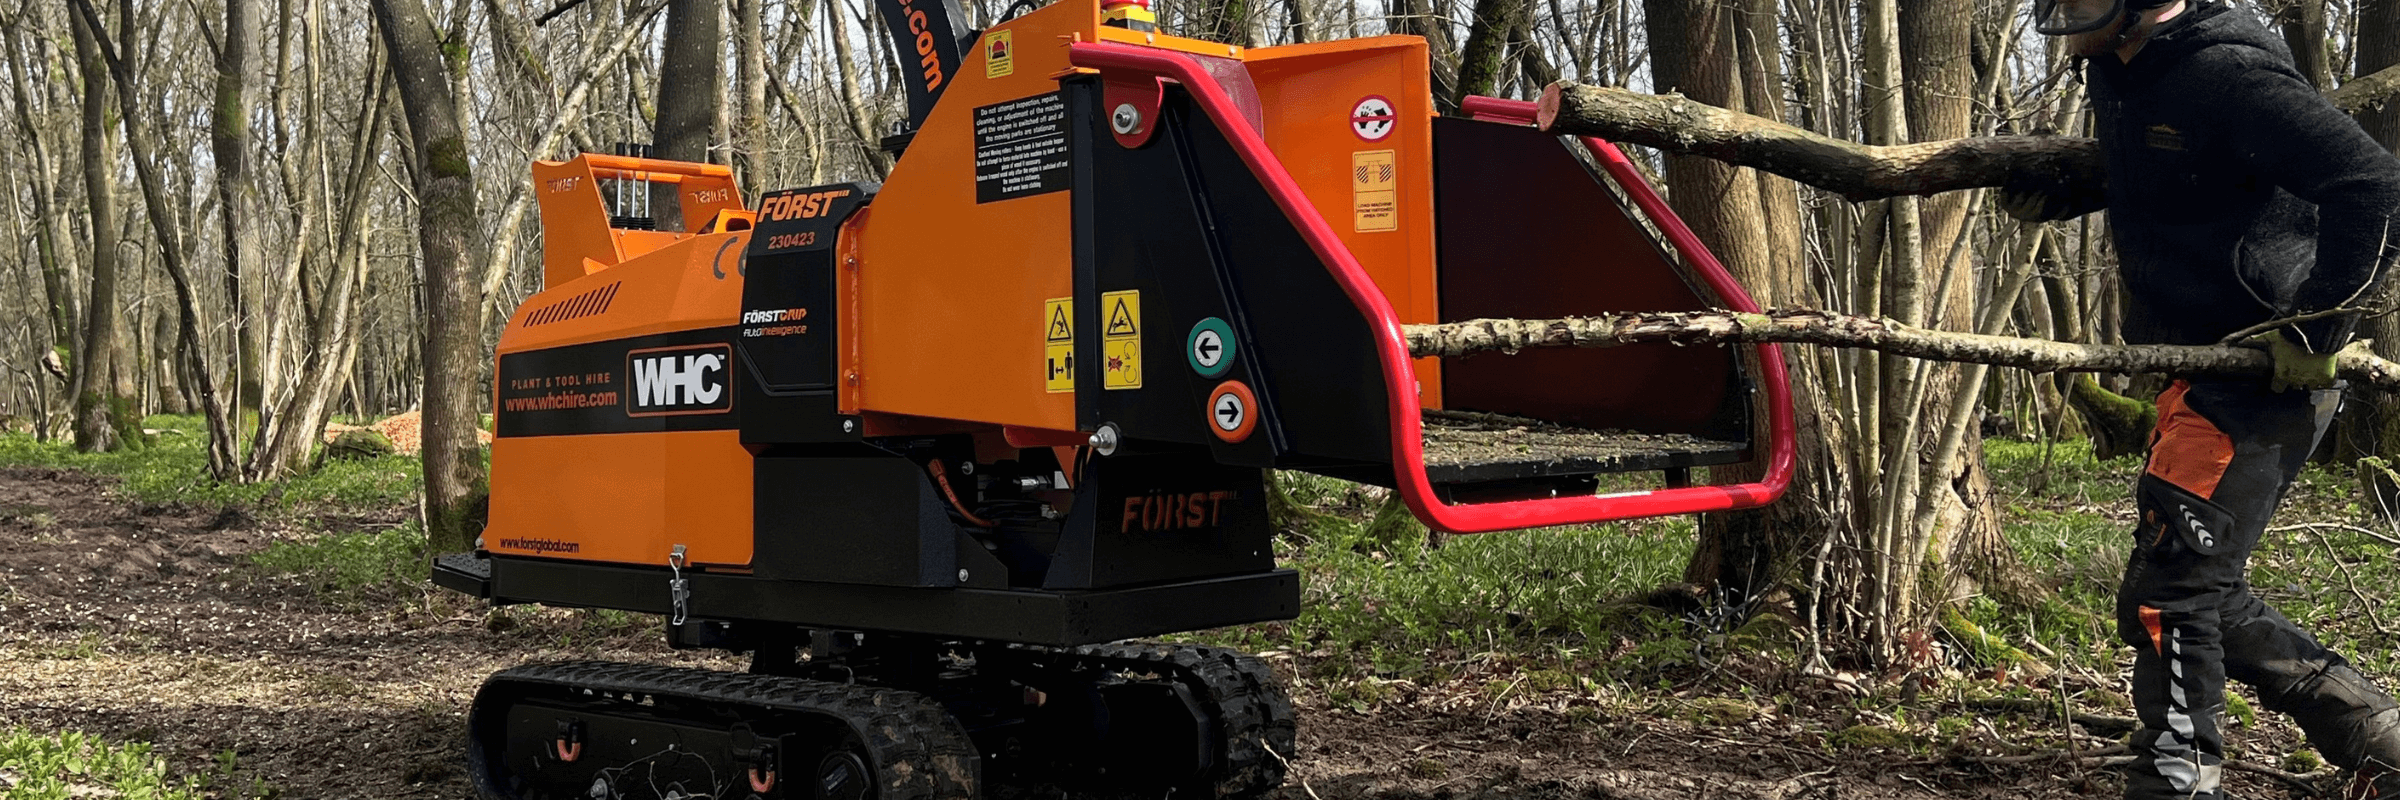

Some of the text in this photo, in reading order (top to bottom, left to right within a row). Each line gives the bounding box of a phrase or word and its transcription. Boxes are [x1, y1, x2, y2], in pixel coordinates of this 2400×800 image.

[757, 190, 850, 223] FÖRST
[768, 231, 815, 249] 230423
[511, 372, 611, 390] PLANT & TOOL HIRE
[634, 354, 722, 407] WHC
[505, 390, 618, 412] www.whchire.com
[1121, 488, 1238, 534] FÖRST
[499, 536, 580, 554] www.forstglobal.com
